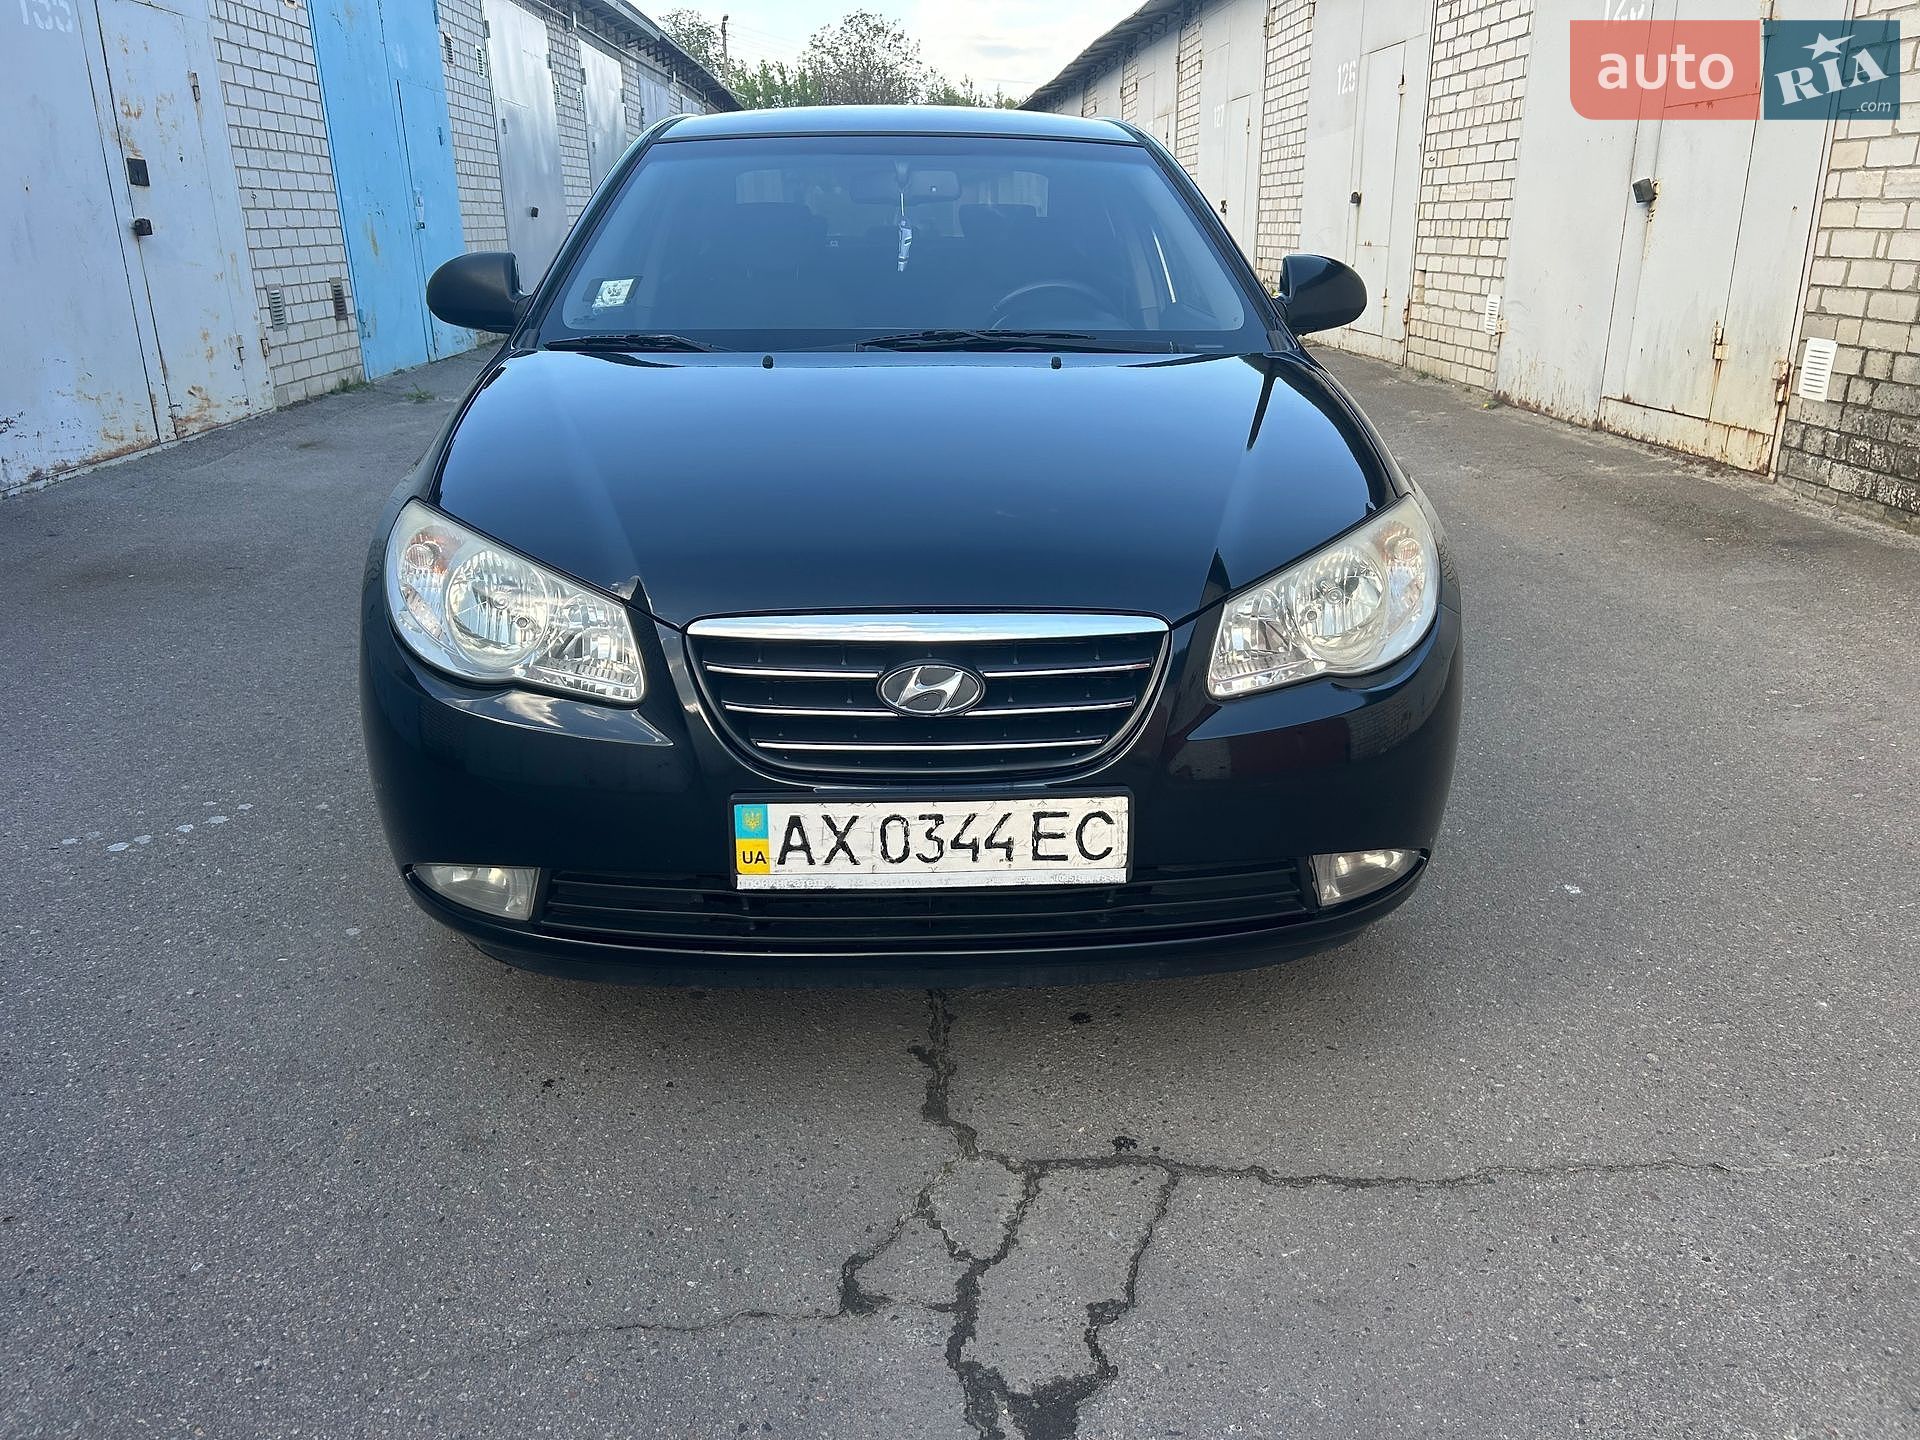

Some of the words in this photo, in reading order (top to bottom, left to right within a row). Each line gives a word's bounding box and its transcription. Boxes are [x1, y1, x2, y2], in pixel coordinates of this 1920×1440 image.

[1337, 61, 1357, 95] 126
[776, 813, 860, 866] AX
[879, 812, 1014, 864] 0344
[1031, 810, 1115, 862] EC
[741, 850, 767, 865] UA
